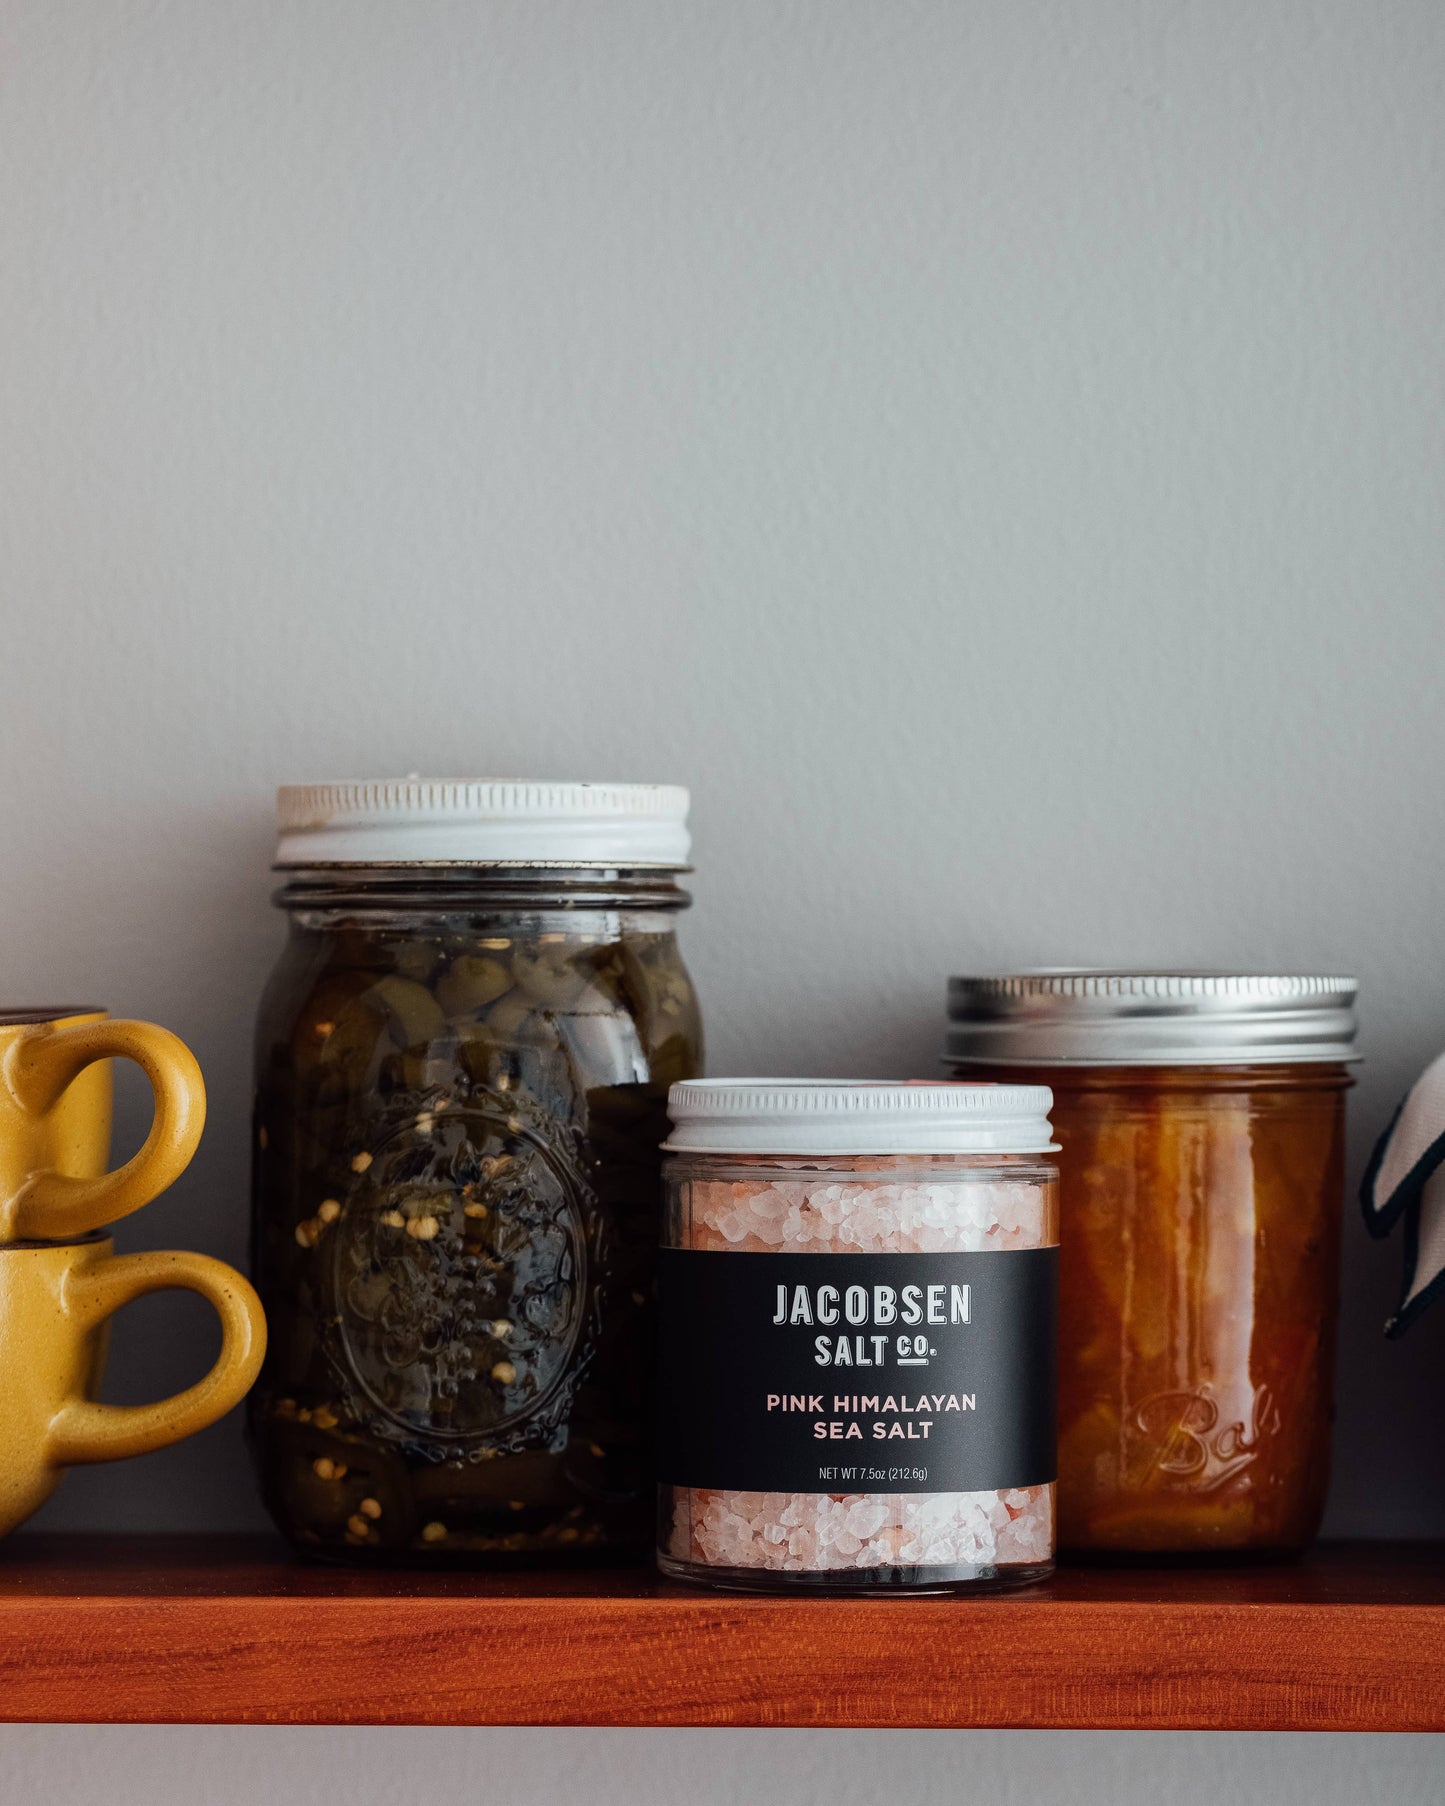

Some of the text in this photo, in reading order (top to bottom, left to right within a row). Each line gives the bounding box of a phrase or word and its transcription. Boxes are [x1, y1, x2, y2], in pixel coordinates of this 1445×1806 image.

[772, 1284, 972, 1326] JACOBSEN
[814, 1335, 938, 1367] SALT CO.
[767, 1393, 977, 1413] PINK HIMALAYAN
[813, 1421, 934, 1440] SEA SALT
[819, 1467, 928, 1481] NET WT 7.5oz (212.6g)
